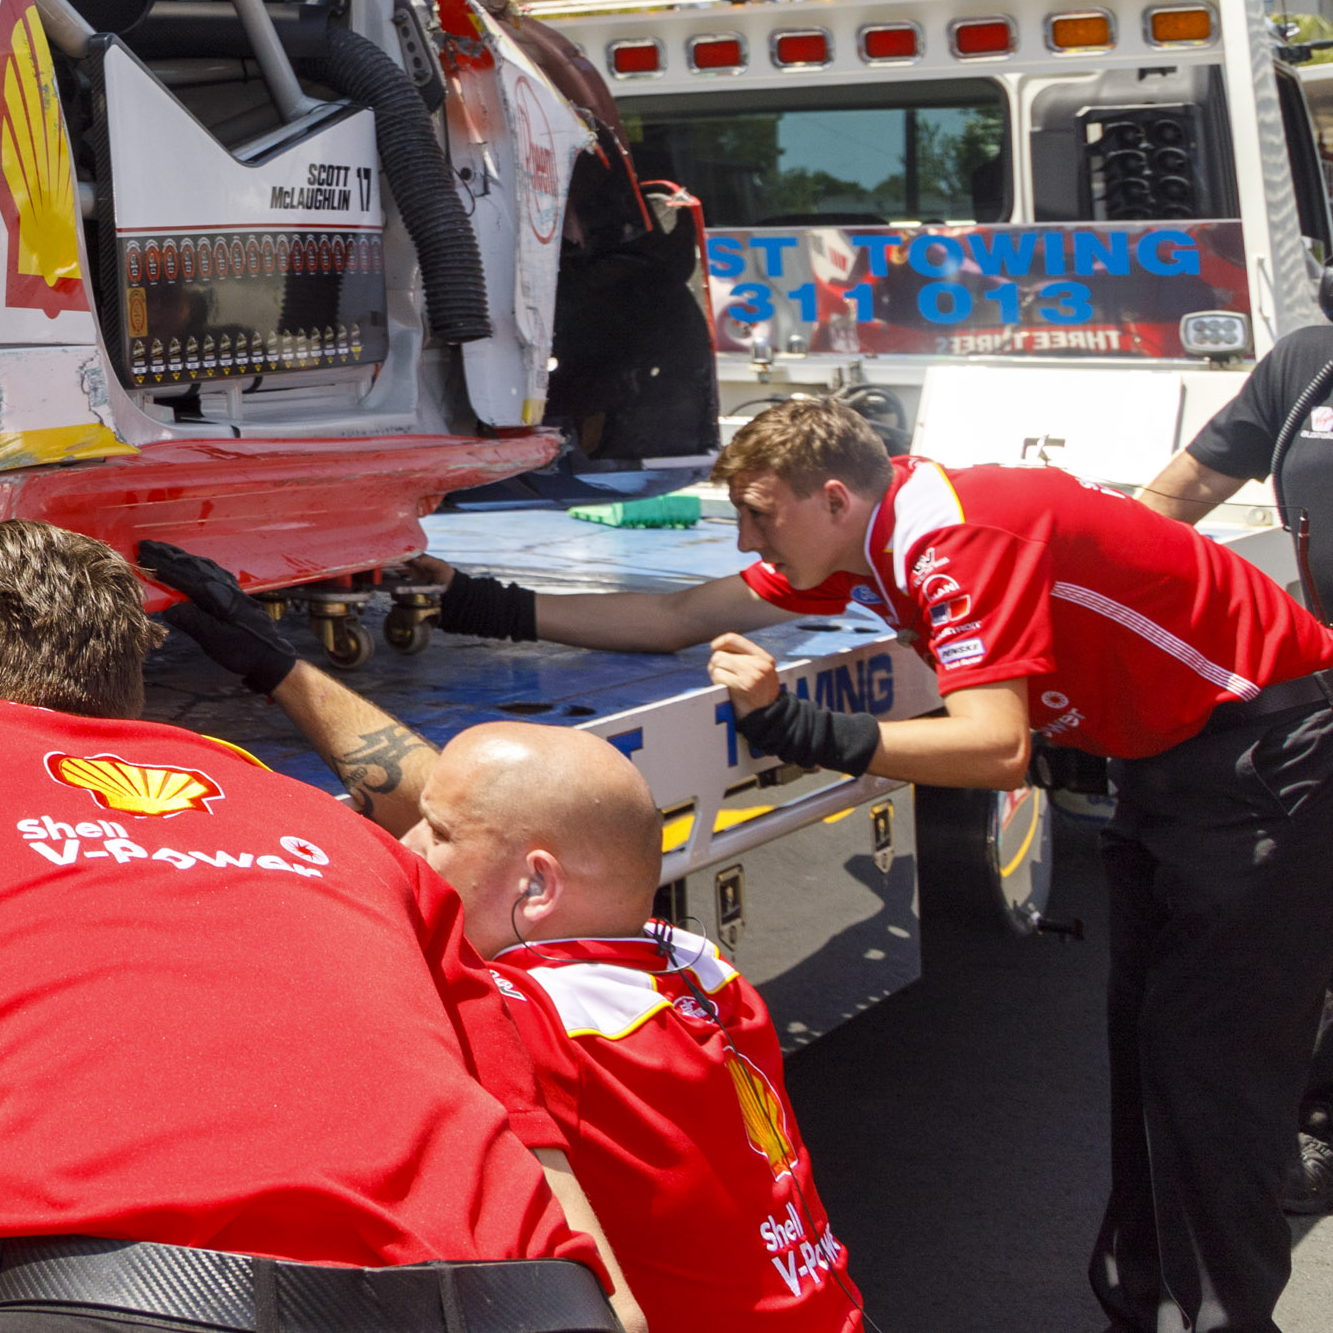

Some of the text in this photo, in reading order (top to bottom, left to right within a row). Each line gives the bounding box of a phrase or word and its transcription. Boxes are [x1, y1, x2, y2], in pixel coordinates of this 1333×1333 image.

[308, 163, 350, 187] SCOTT
[356, 167, 372, 212] 17
[270, 186, 351, 211] McLAUGHLIN
[852, 230, 1200, 278] TOWING
[917, 281, 1093, 325] 013
[17, 815, 130, 840] Shell
[760, 1202, 804, 1253] Shell
